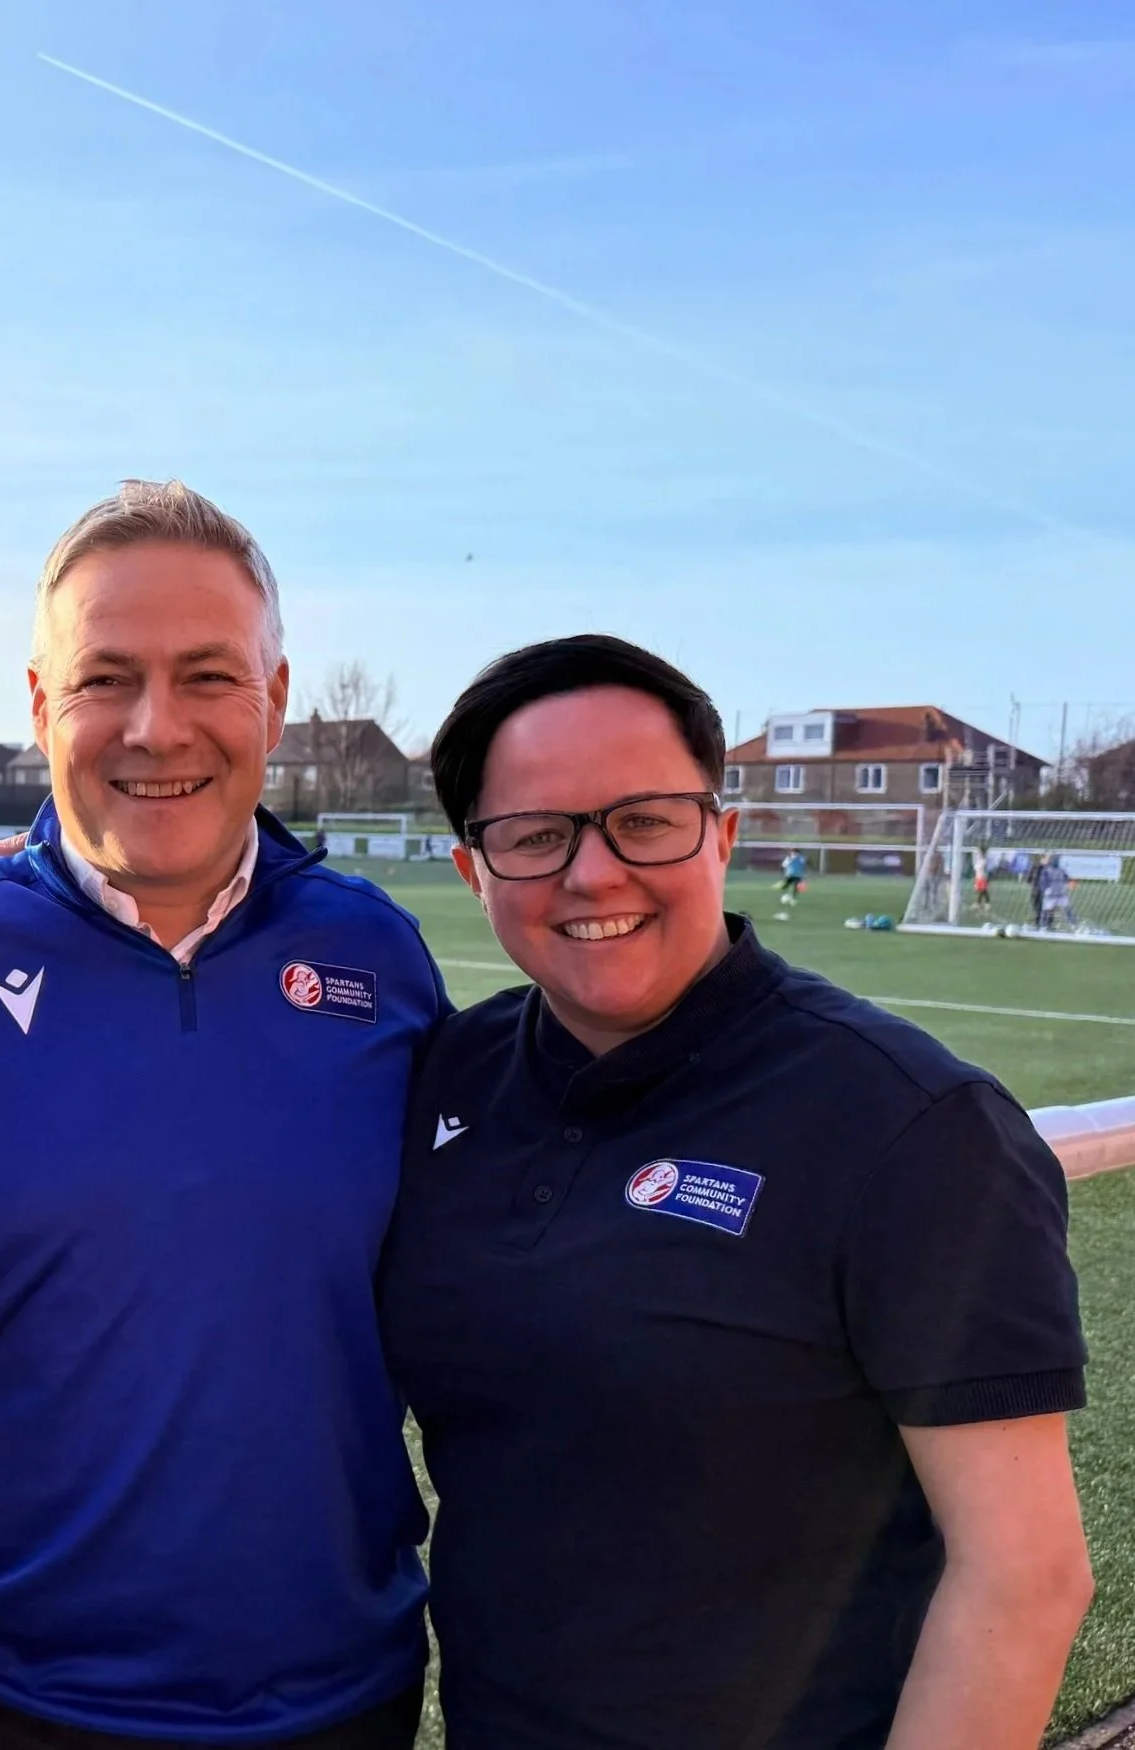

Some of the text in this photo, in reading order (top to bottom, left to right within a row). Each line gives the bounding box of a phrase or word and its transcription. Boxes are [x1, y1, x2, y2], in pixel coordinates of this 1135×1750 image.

[325, 977, 364, 990] SPARTANS
[326, 986, 372, 1000] COMMUNITY
[327, 994, 373, 1008] FOUNDATION
[683, 1174, 736, 1192] SPARTANS
[680, 1184, 746, 1206] COMMUNITY
[675, 1193, 742, 1217] FOUNDATION
